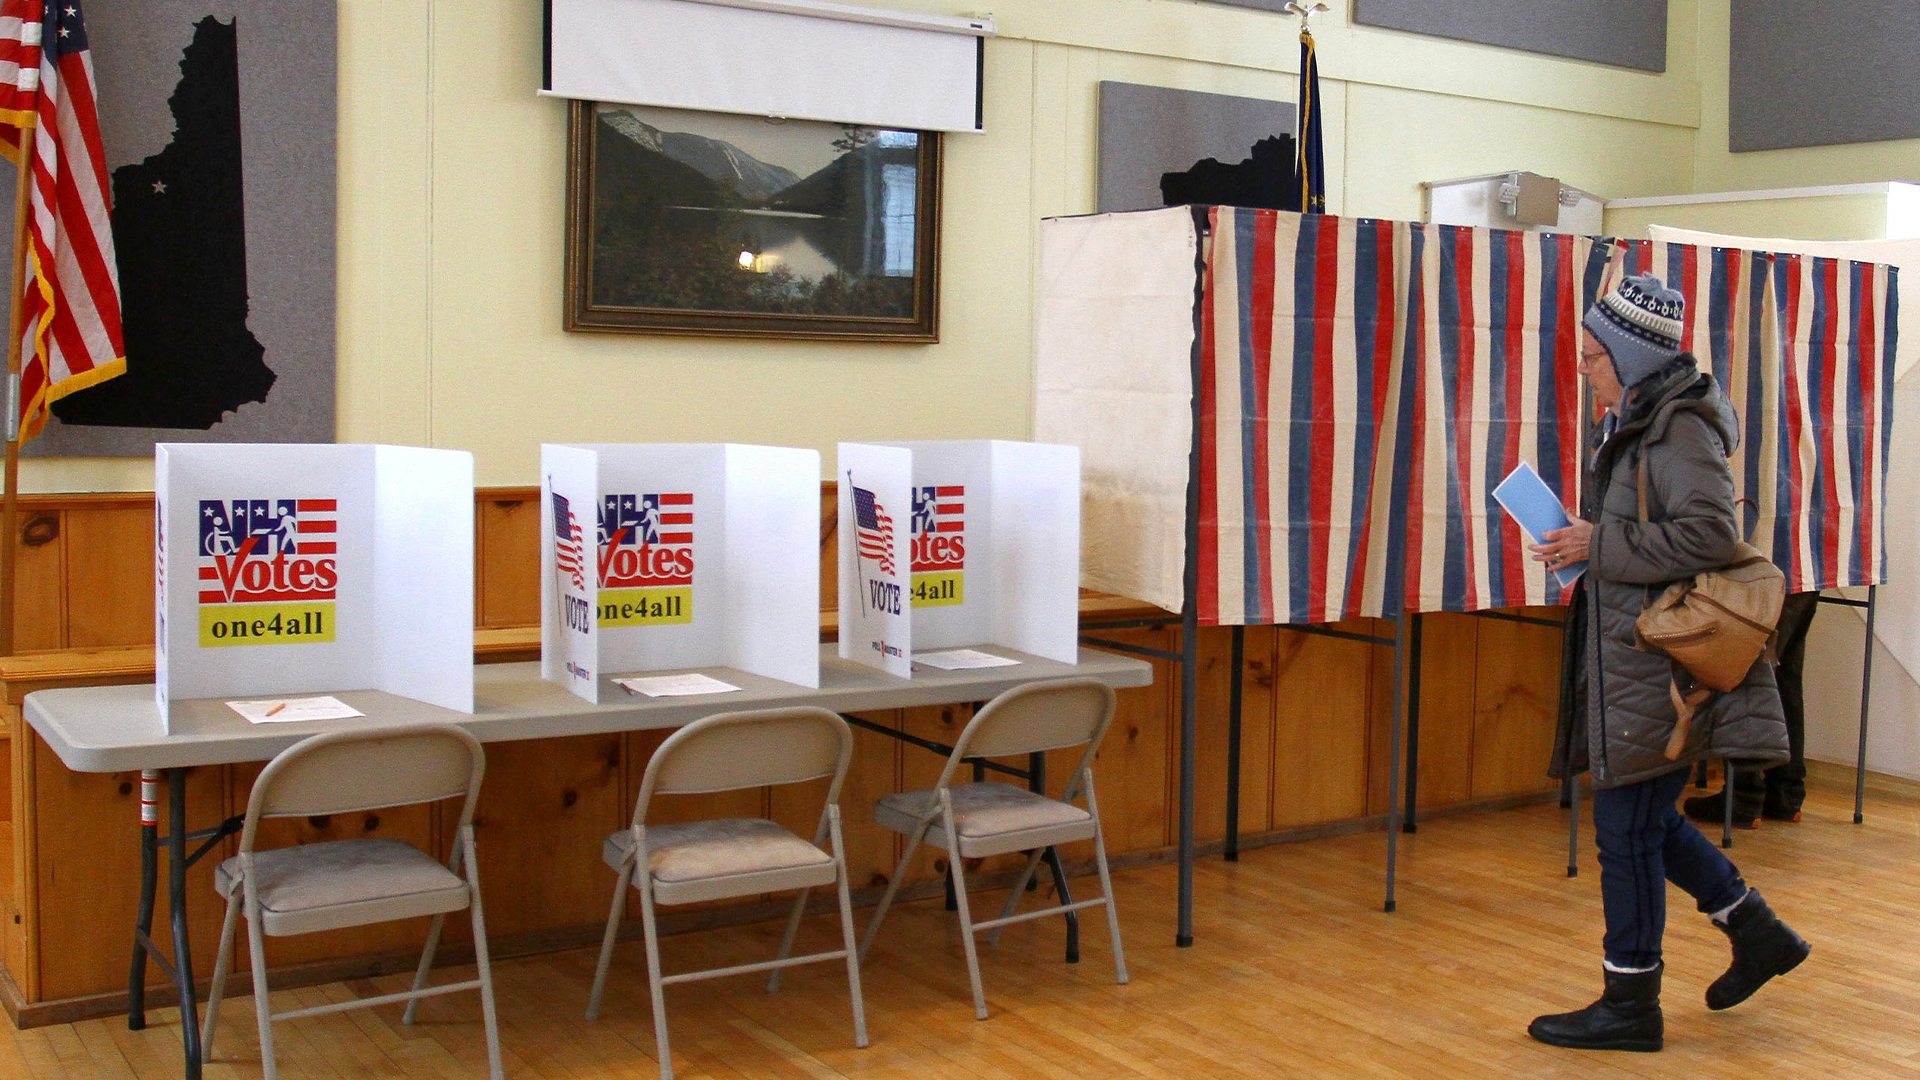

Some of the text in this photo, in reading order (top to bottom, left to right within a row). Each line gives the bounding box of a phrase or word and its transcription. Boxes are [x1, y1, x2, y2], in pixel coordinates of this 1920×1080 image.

[199, 500, 297, 556] NH
[215, 537, 338, 602] Votes
[597, 596, 681, 620] ne4all
[869, 579, 901, 616] VOTE
[911, 579, 954, 601] 4all
[212, 612, 323, 639] one4all
[565, 593, 589, 635] VOTE
